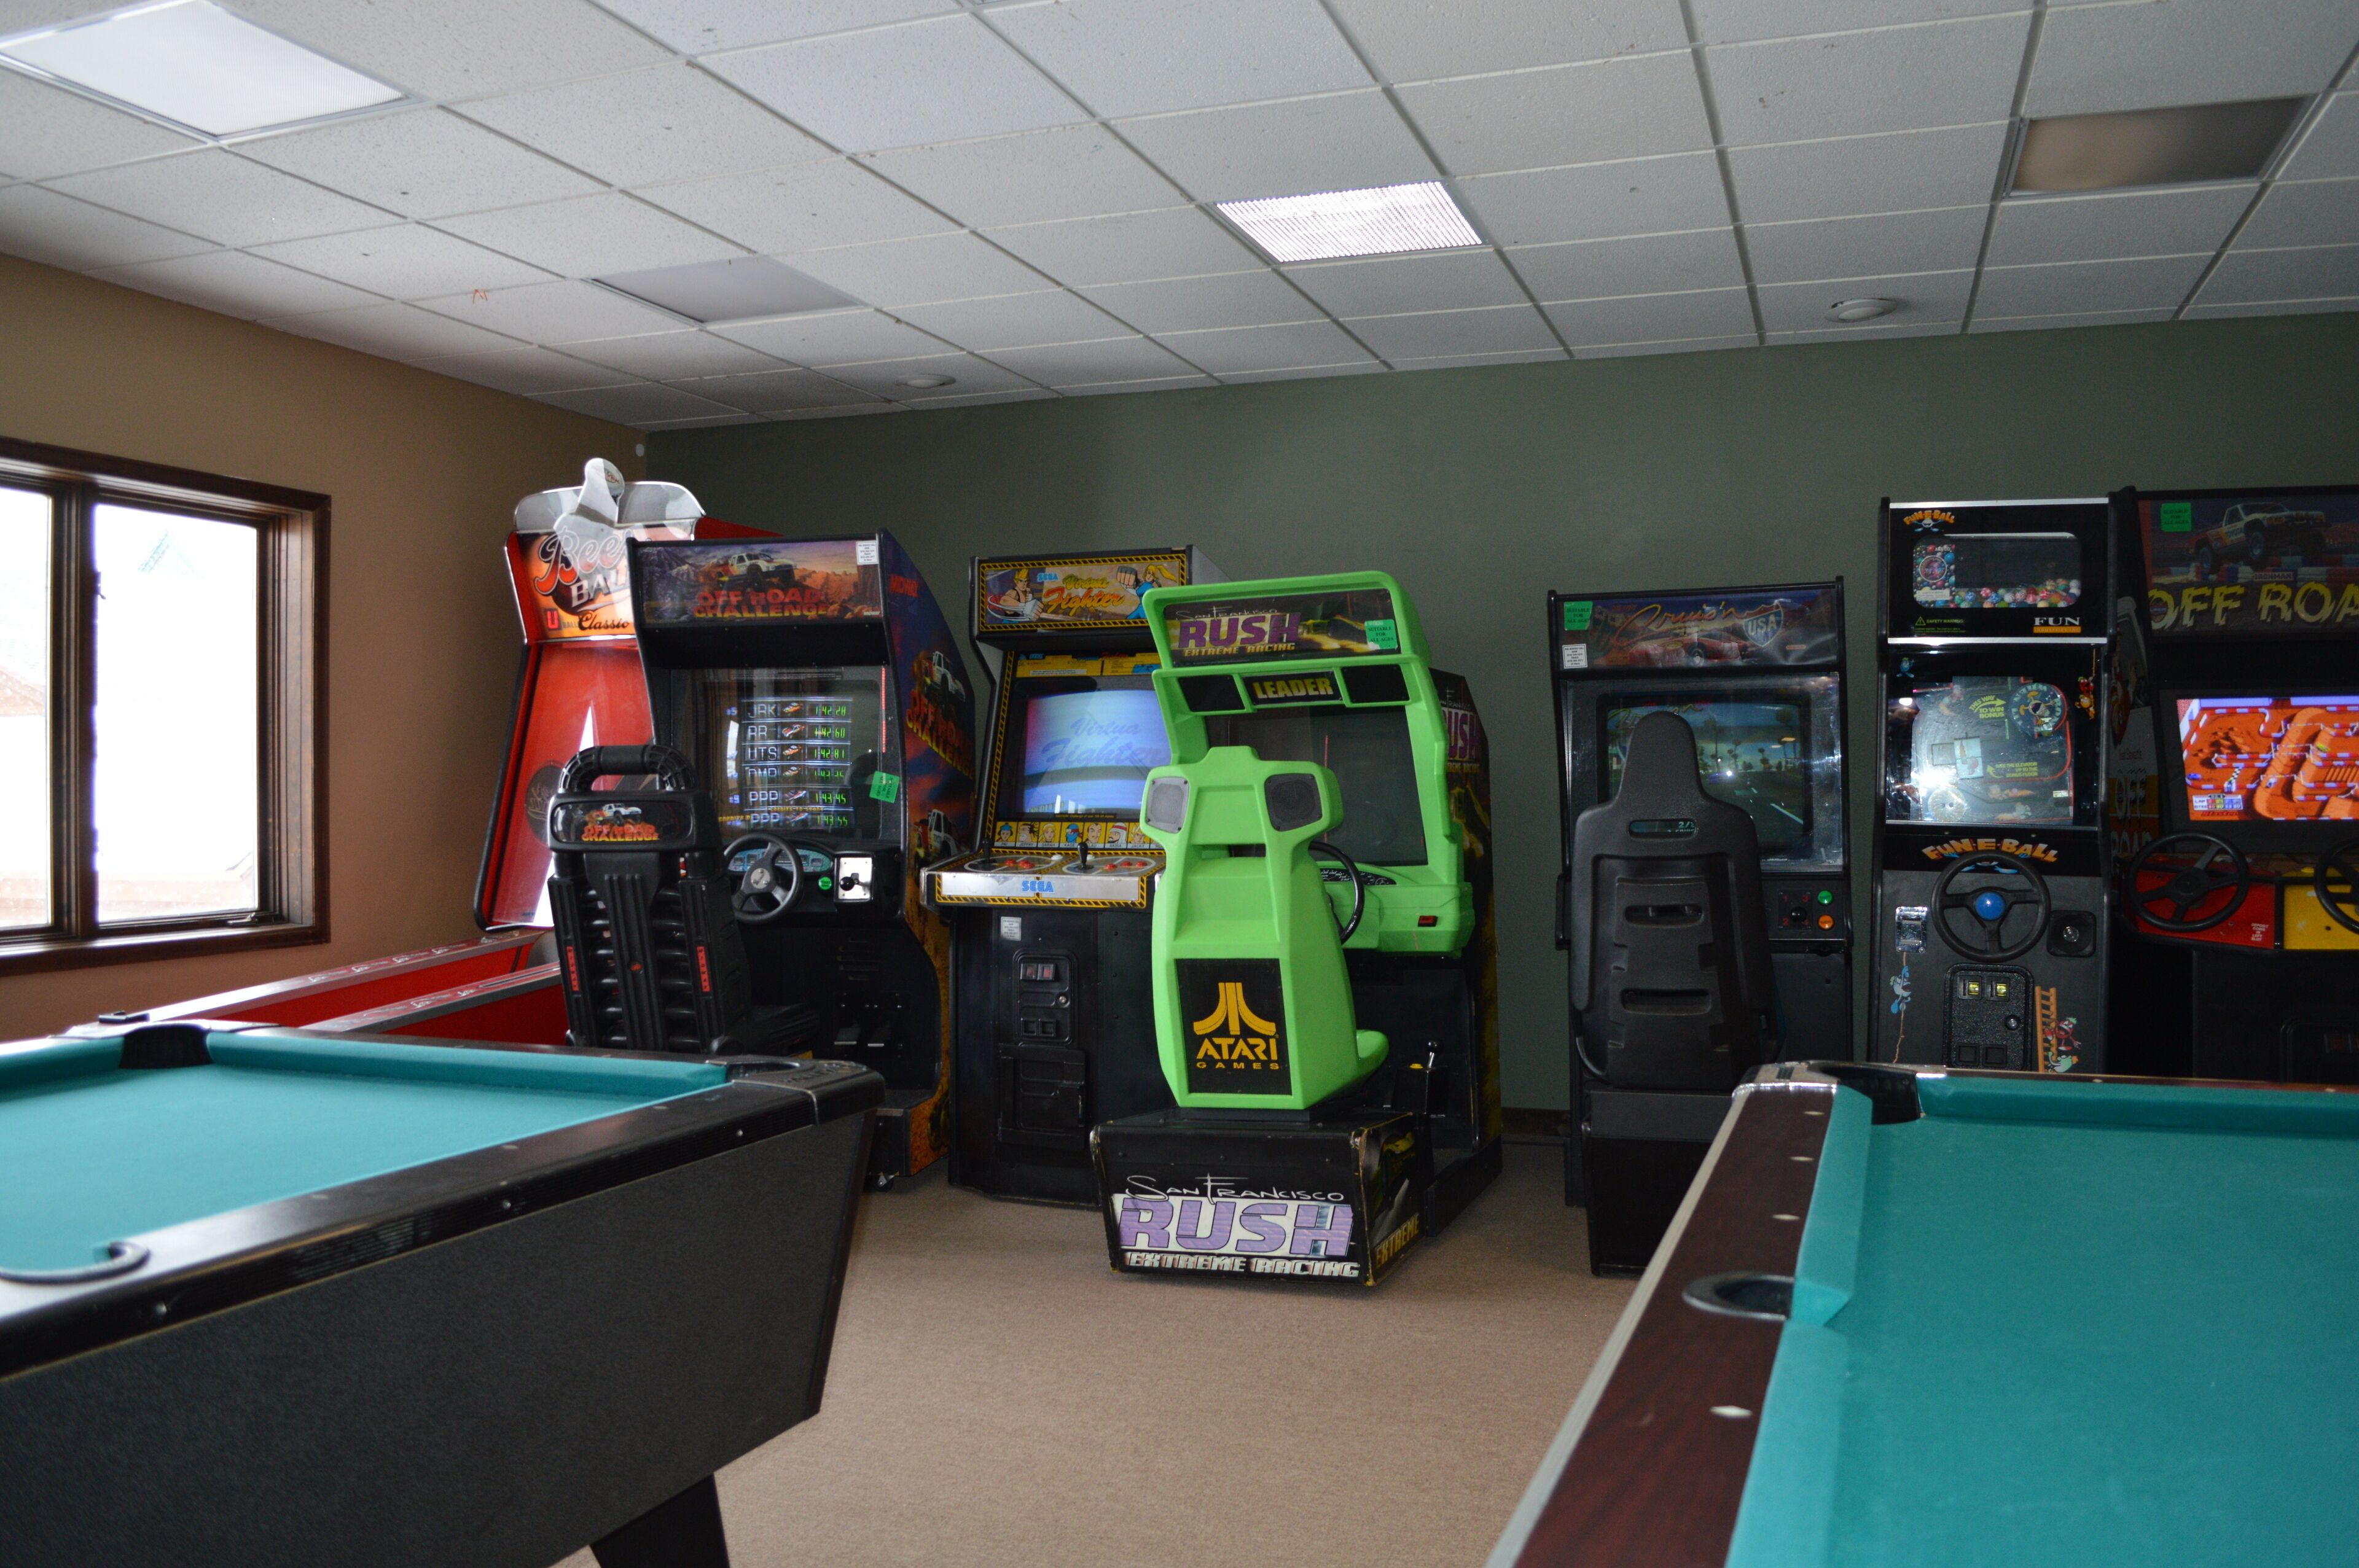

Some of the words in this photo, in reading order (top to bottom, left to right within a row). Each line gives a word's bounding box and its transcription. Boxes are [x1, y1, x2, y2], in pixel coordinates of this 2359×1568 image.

[571, 563, 632, 608] BAL
[1038, 573, 1060, 583] SEGA
[1062, 574, 1110, 590] Virtua
[697, 589, 743, 606] OFF
[749, 588, 823, 606] ROAD
[1043, 586, 1126, 617] Fighter
[2148, 585, 2245, 630] OFF
[2258, 582, 2359, 623] ROA
[578, 609, 630, 631] Classic
[693, 603, 829, 618] CHALLENGE
[1178, 612, 1302, 649] RUSH
[1748, 614, 1777, 636] USA
[2033, 617, 2081, 626] FUN
[1184, 647, 1239, 658] EXTREME
[1245, 643, 1296, 654] RACING
[1253, 677, 1334, 699] LEADER
[1969, 697, 1981, 711] THIS
[1070, 717, 1140, 736] Virtua
[581, 831, 660, 842] CHALLENGE
[584, 824, 611, 835] OFF
[1022, 880, 1054, 892] SEGA
[1196, 1037, 1278, 1061] ATARI
[1195, 1061, 1280, 1071] GAMES
[1119, 1197, 1354, 1257] RUSH
[1375, 1211, 1420, 1269] EXTREME
[1125, 1252, 1248, 1273] EXTREME
[1249, 1257, 1361, 1277] RACING
